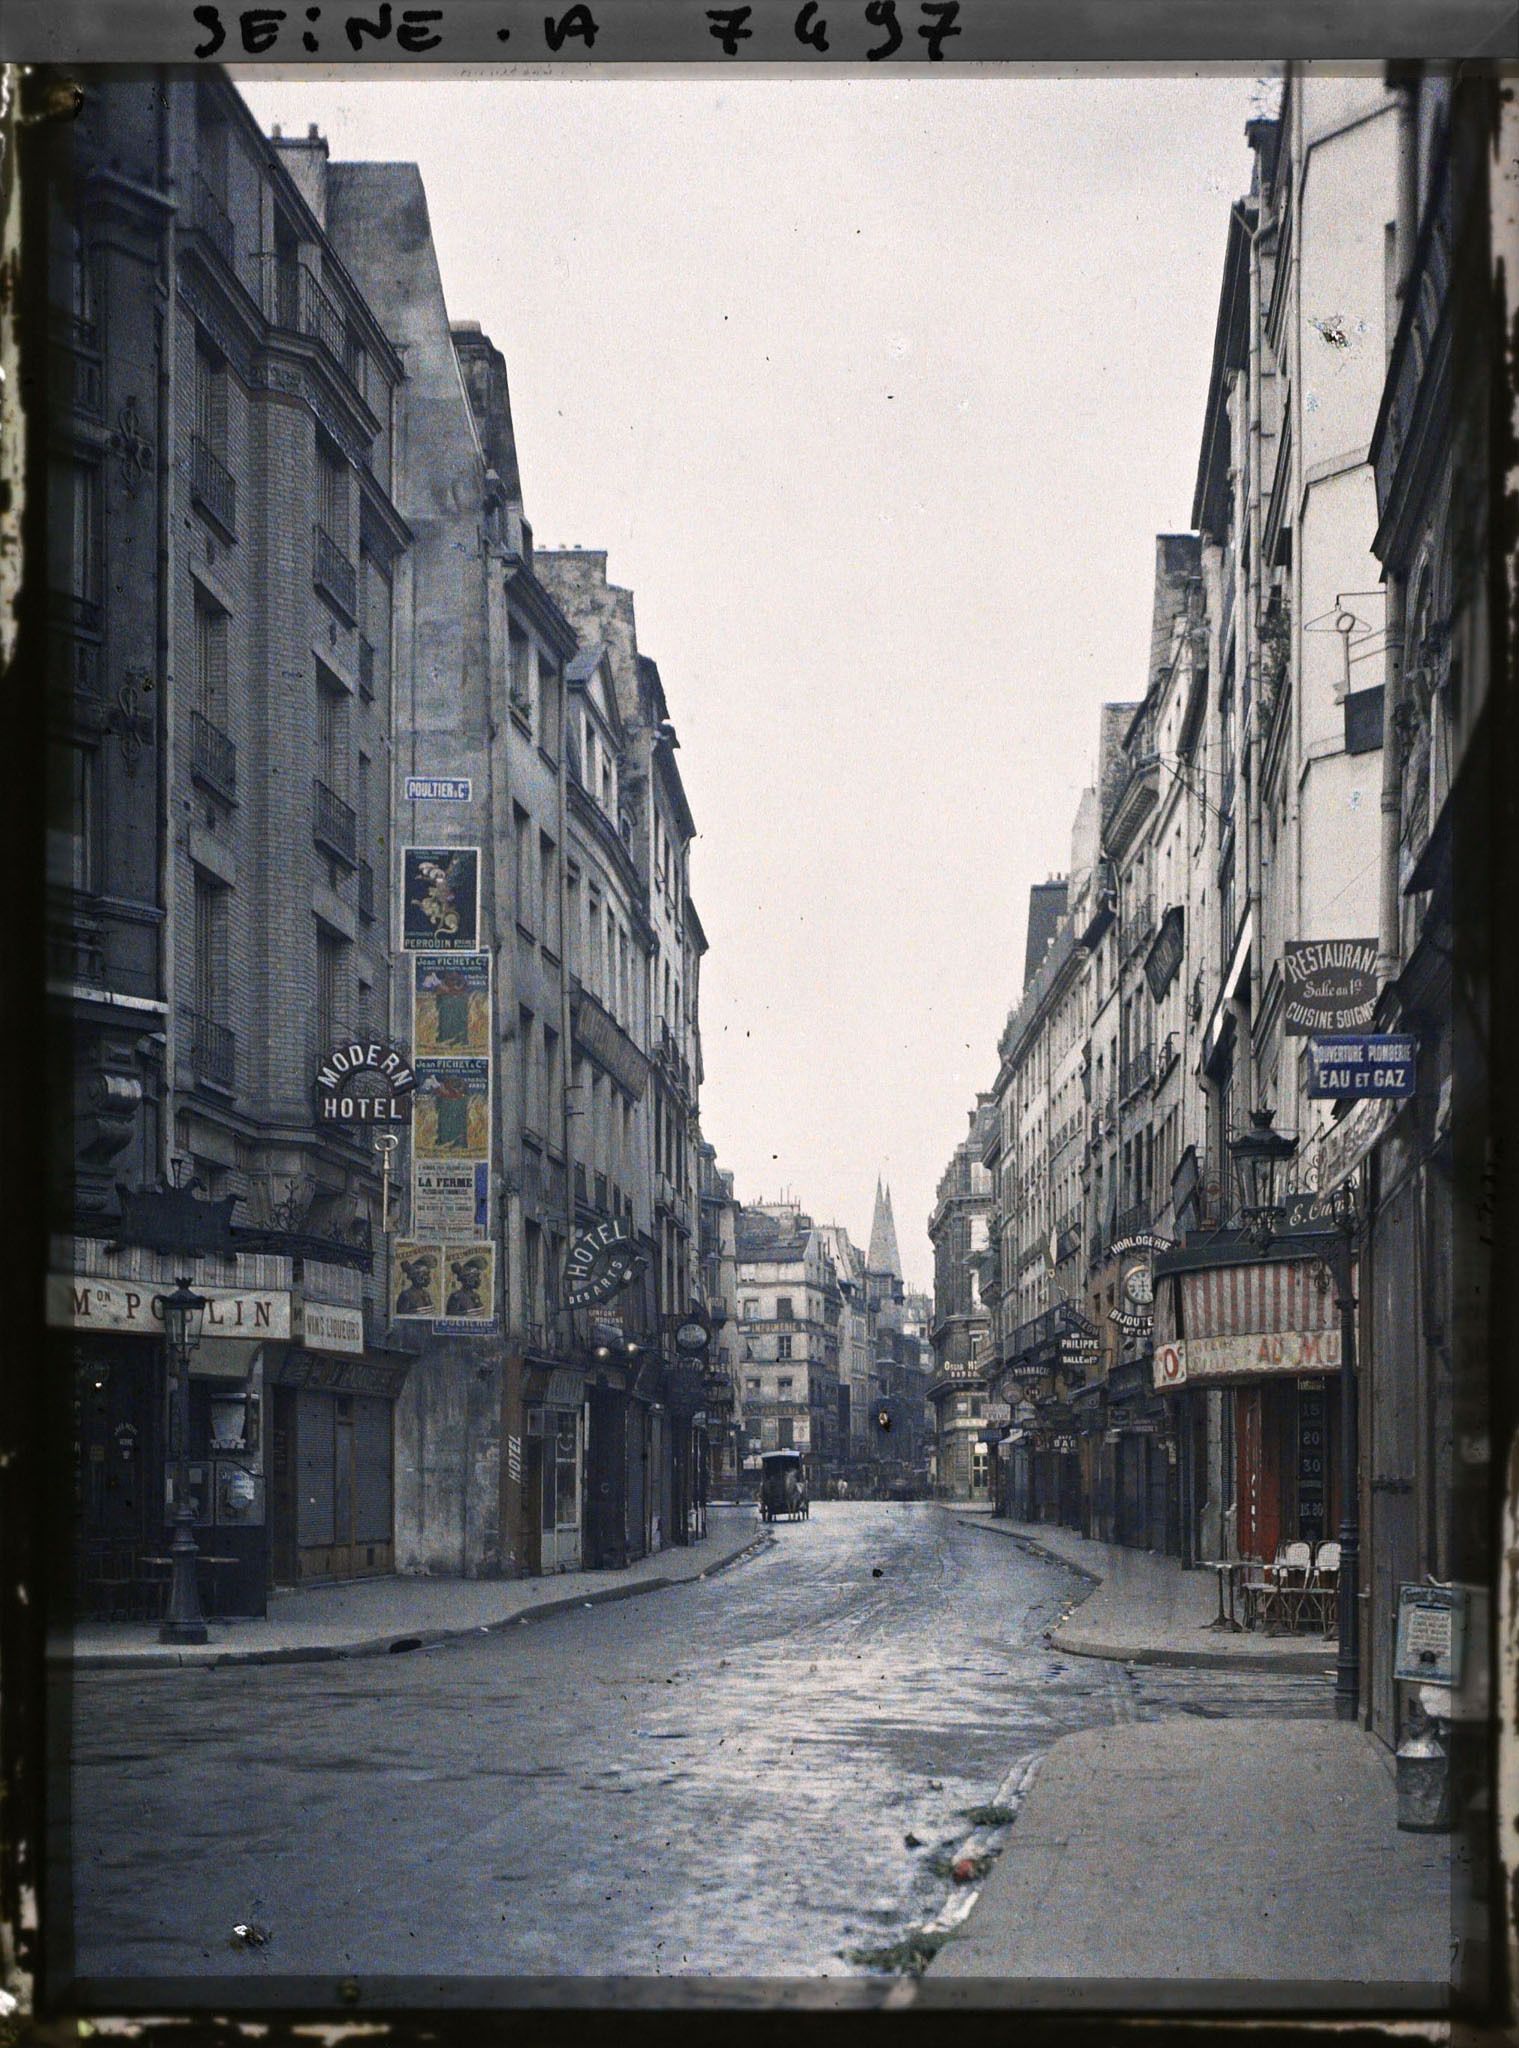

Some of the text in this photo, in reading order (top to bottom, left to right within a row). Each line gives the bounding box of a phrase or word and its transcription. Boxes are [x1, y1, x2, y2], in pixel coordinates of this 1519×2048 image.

[410, 782, 453, 799] POULTIER
[1286, 1002, 1334, 1029] CUISINE
[1368, 1044, 1412, 1062] PLOMBERIE
[317, 1044, 414, 1089] MODERN
[1319, 1069, 1406, 1089] EAU ET GAZ
[324, 1098, 403, 1119] HOTEL
[418, 1177, 473, 1188] LA FERME
[567, 1219, 628, 1278] HOTEL
[1111, 1235, 1172, 1255] HORLOGERIE
[569, 1260, 623, 1305] DES ARTS
[127, 1292, 272, 1328] POLIN
[326, 1317, 362, 1341] LIQUEURS
[1061, 1339, 1100, 1349] PHILIPPE
[508, 1434, 521, 1484] HOTEL
[1302, 1458, 1321, 1473] 30
